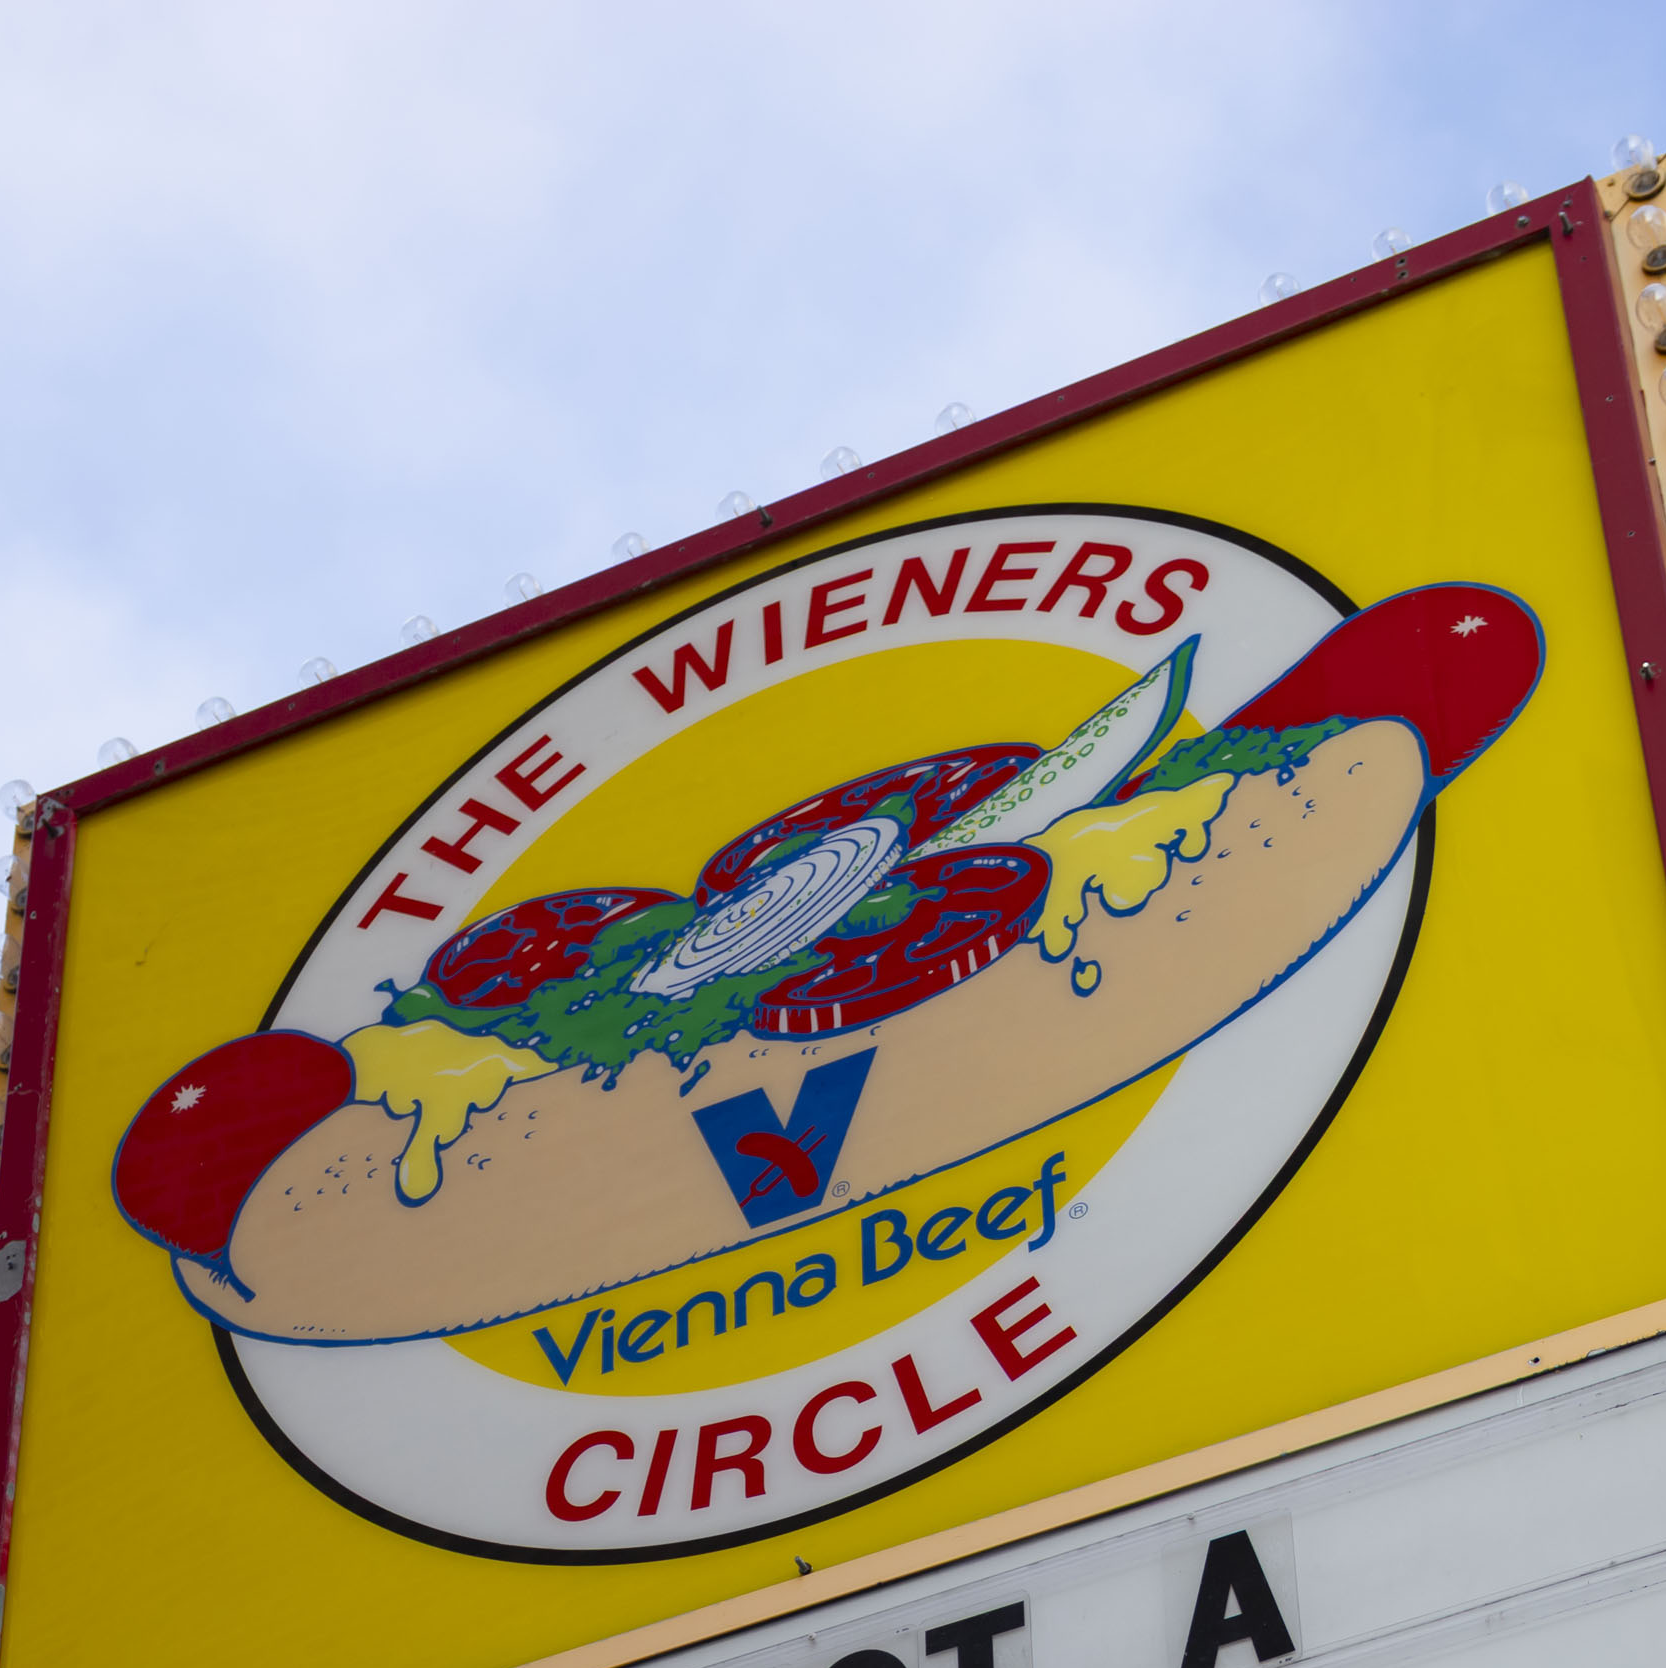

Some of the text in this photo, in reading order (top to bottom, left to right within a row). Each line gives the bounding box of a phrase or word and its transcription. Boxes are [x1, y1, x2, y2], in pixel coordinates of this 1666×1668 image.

[357, 540, 1210, 931] THE WIENERS
[532, 1253, 836, 1387] Vienna
[545, 1275, 1078, 1523] CIRCLE
